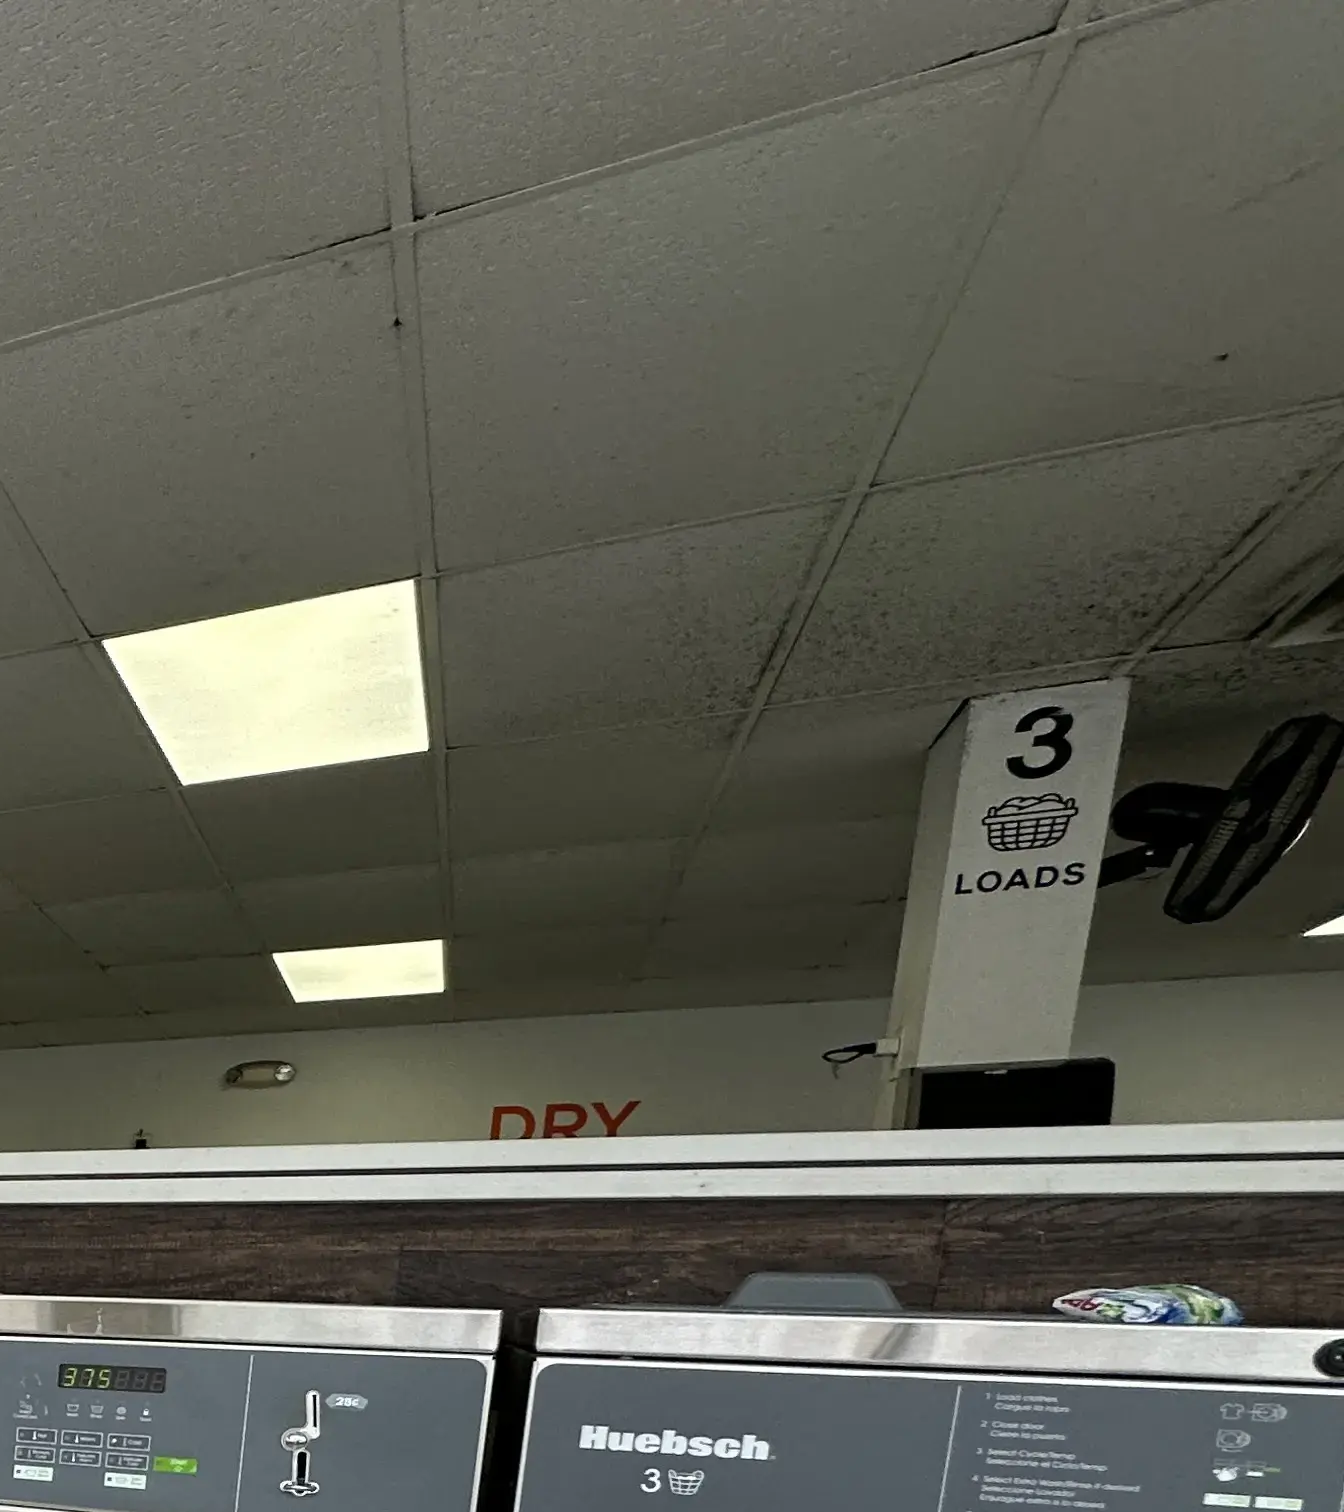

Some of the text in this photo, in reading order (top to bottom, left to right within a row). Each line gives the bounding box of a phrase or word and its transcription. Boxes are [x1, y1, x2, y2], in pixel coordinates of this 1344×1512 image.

[1005, 706, 1074, 779] 3
[955, 862, 1085, 895] LOADS
[490, 1100, 642, 1140] DRY
[63, 1367, 112, 1389] 375
[579, 1424, 770, 1461] Huebsch
[640, 1468, 662, 1493] 3
